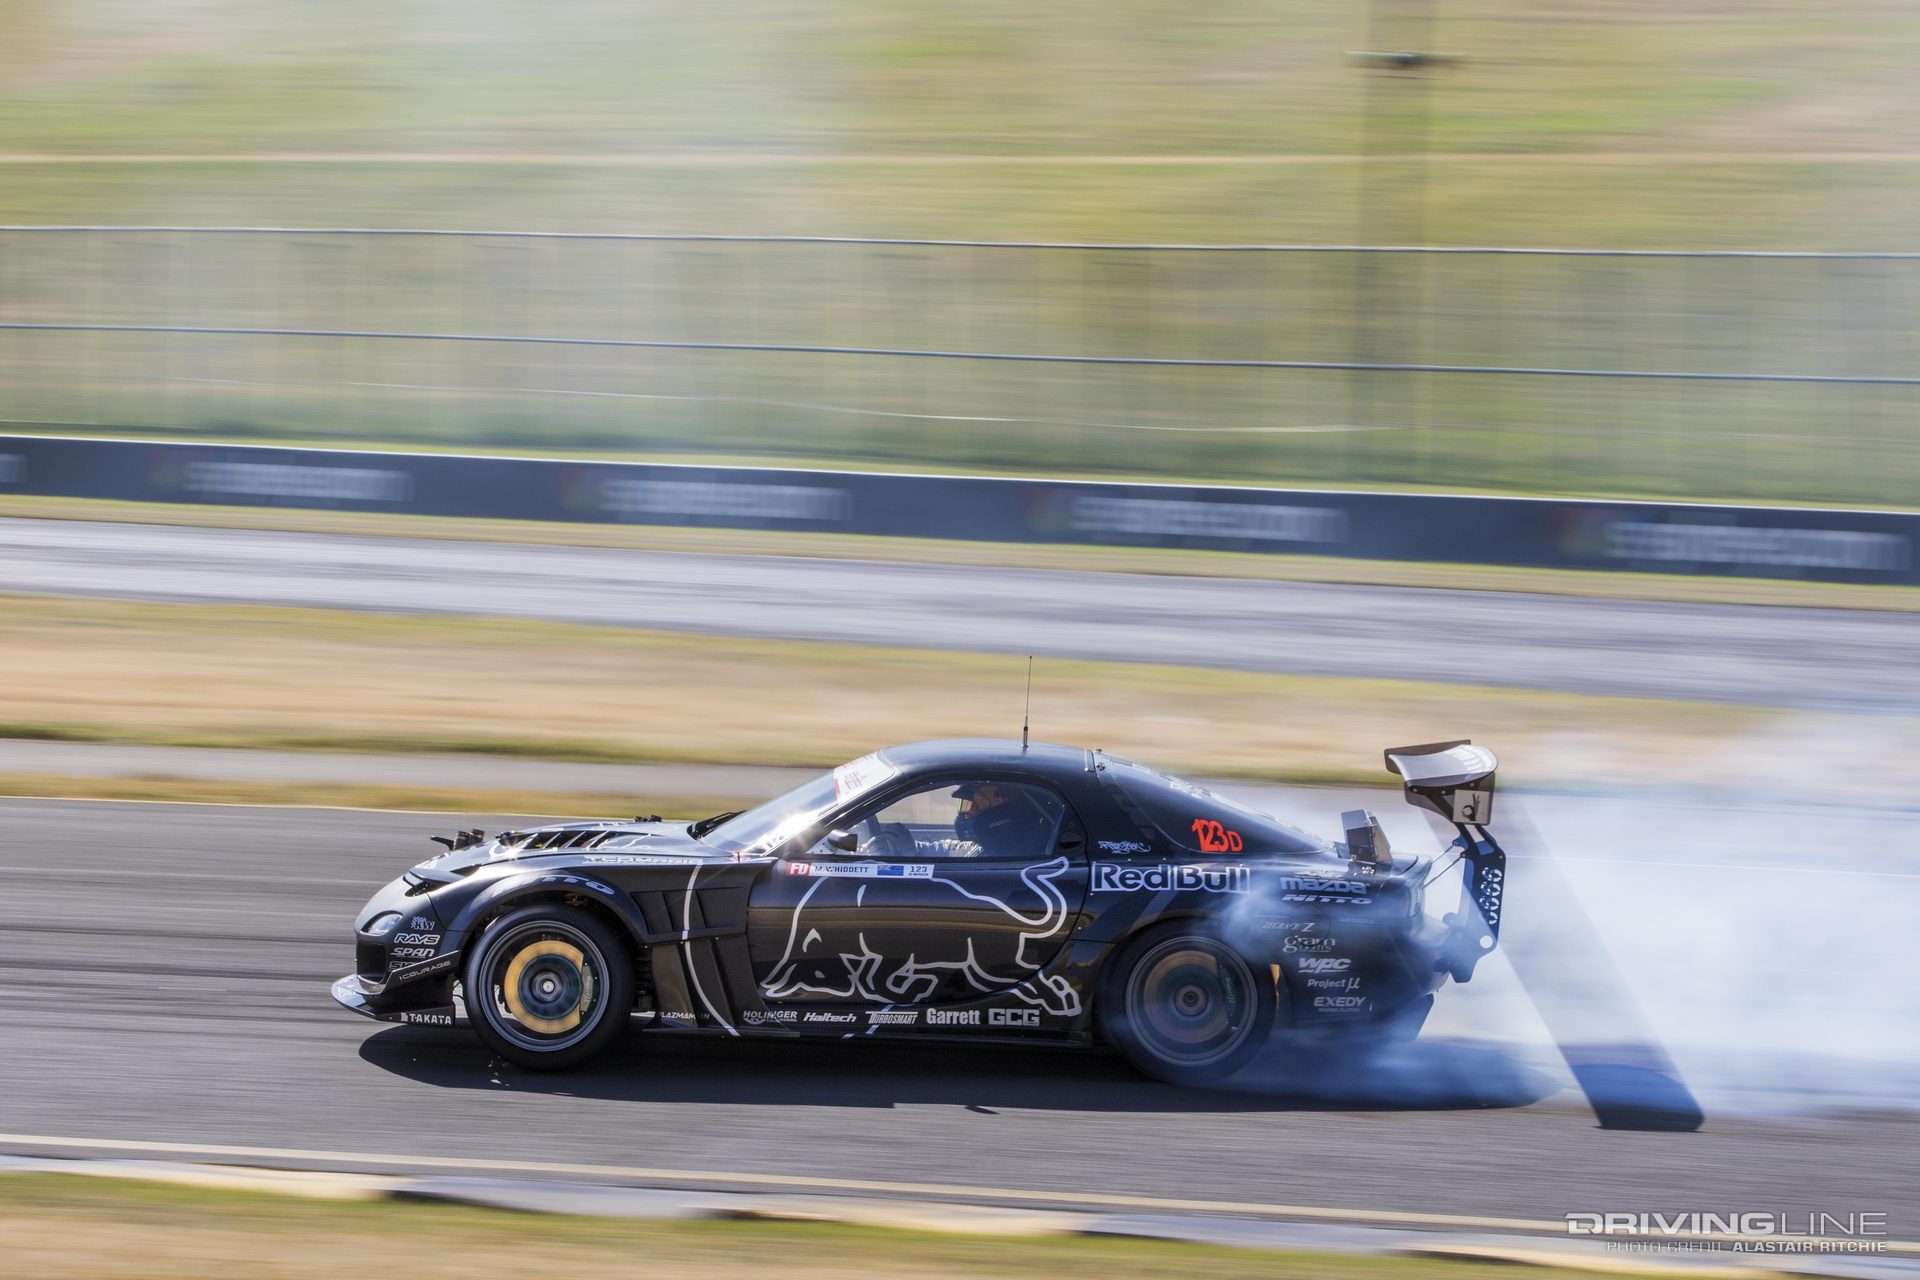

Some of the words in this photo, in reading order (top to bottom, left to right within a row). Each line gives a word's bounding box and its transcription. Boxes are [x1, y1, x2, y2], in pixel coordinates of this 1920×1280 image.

[790, 862, 809, 875] FD
[910, 865, 928, 873] 123
[1091, 863, 1171, 892] Red
[1173, 865, 1250, 893] Bull
[1281, 894, 1373, 904] NITTO
[394, 933, 440, 945] RAYS
[1307, 979, 1346, 989] Project
[1313, 996, 1367, 1007] EXEDY
[409, 1013, 452, 1025] TAKATA
[743, 1010, 798, 1019] HOLINGER
[803, 1012, 857, 1023] Haltech
[926, 1008, 981, 1025] Garrett
[988, 1008, 1040, 1026] GCG
